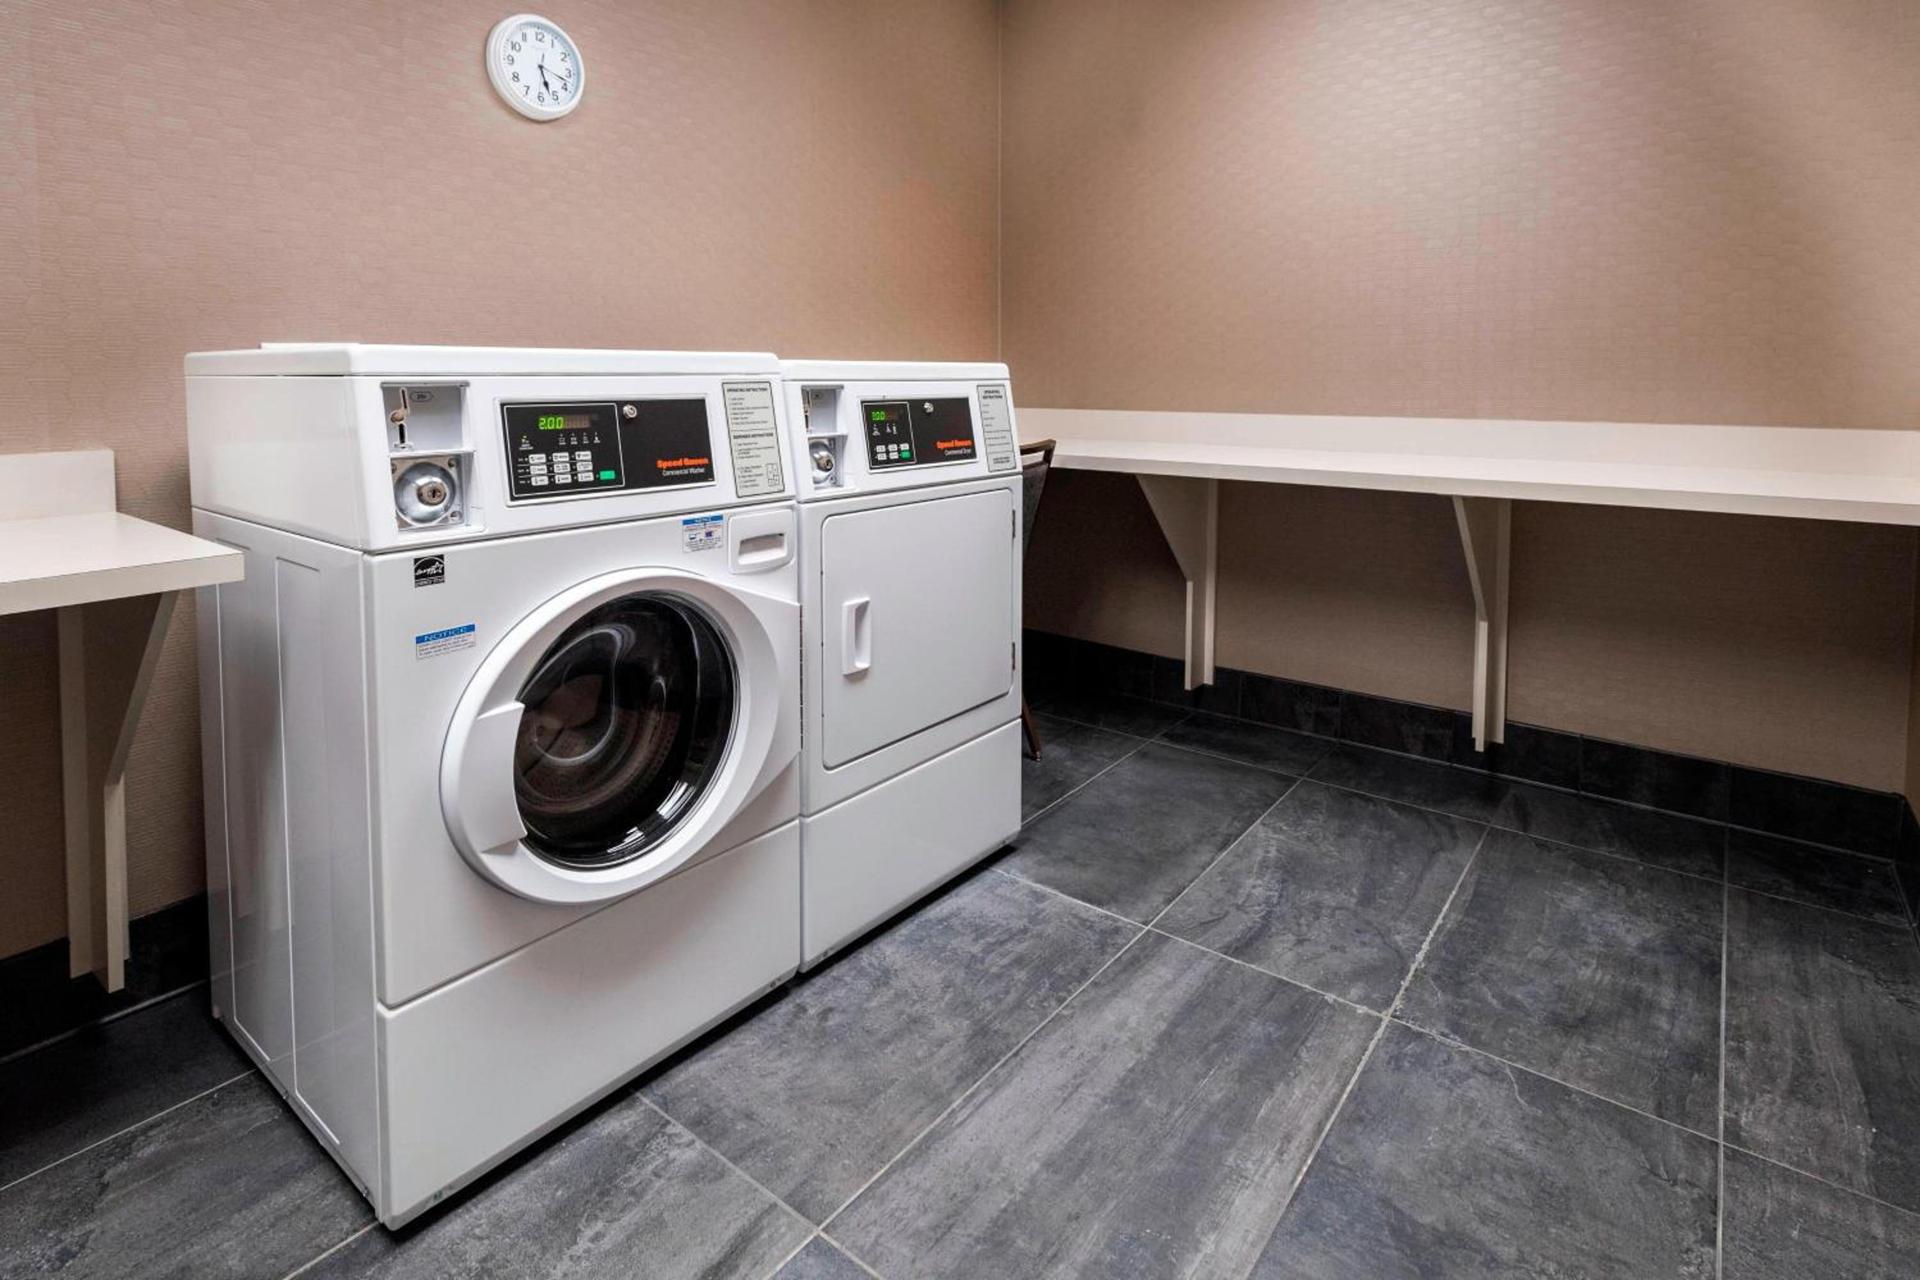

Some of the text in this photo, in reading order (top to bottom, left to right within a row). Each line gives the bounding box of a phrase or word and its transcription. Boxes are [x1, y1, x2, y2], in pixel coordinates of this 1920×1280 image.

[535, 31, 545, 43] 12
[511, 41, 521, 52] 10
[507, 54, 515, 65] 9
[560, 52, 568, 62] 2
[512, 72, 520, 82] 8
[565, 68, 572, 79] 3
[523, 85, 530, 96] 7
[561, 82, 568, 92] 4
[537, 92, 545, 103] 6
[551, 90, 559, 101] 5
